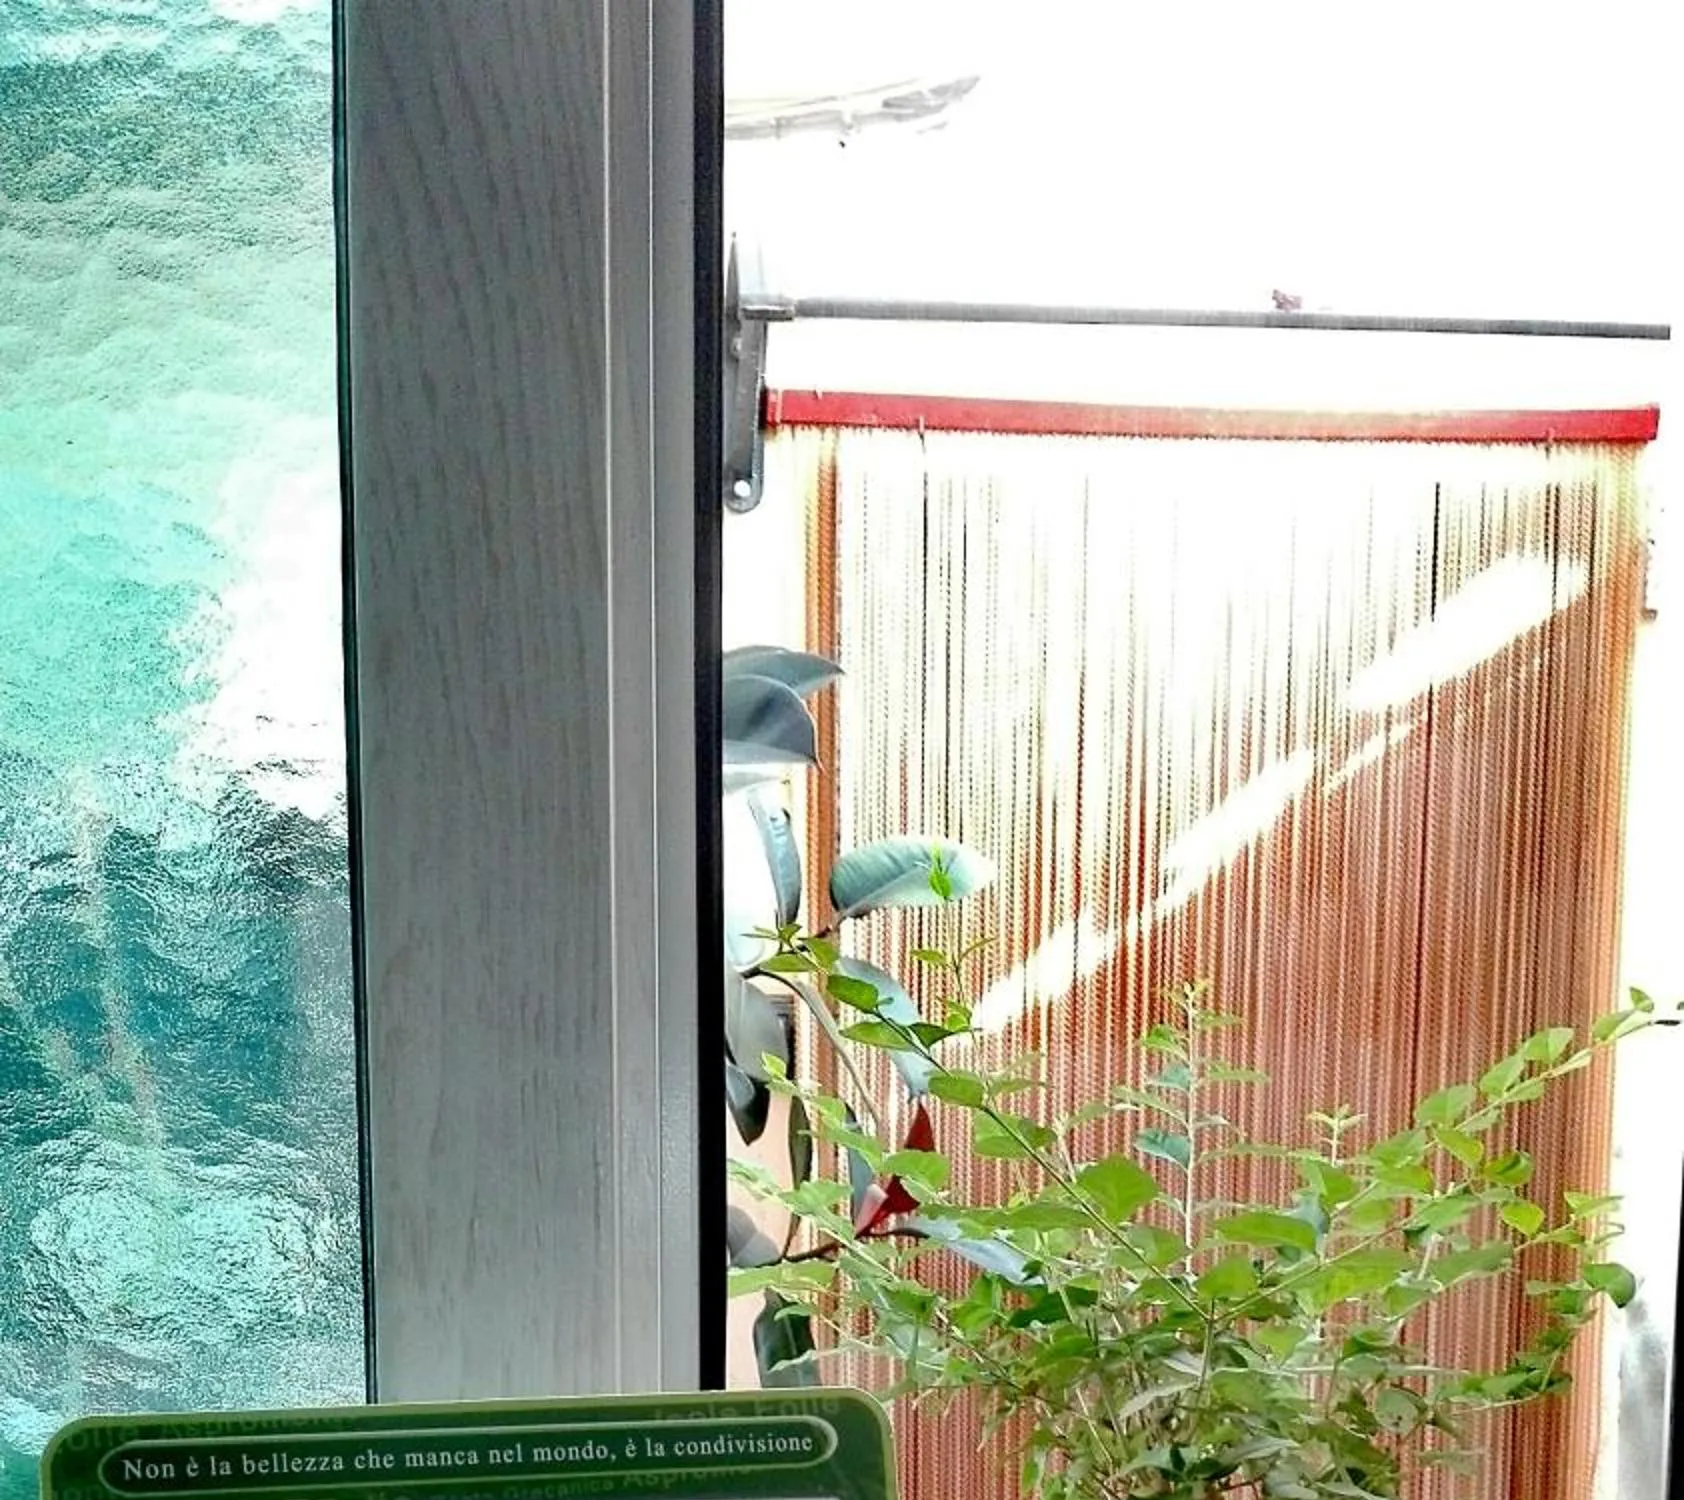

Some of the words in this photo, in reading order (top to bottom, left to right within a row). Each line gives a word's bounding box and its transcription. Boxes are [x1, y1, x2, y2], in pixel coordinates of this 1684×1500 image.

[123, 1458, 176, 1481] Non
[186, 1455, 200, 1477] è
[210, 1455, 232, 1476] la
[242, 1453, 344, 1475] bellezza
[354, 1449, 396, 1470] che
[405, 1450, 480, 1468] manca
[488, 1443, 524, 1464] nel
[532, 1440, 617, 1463] mondo,
[625, 1437, 637, 1458] è
[645, 1437, 666, 1458] la
[674, 1433, 814, 1456] condivisione
